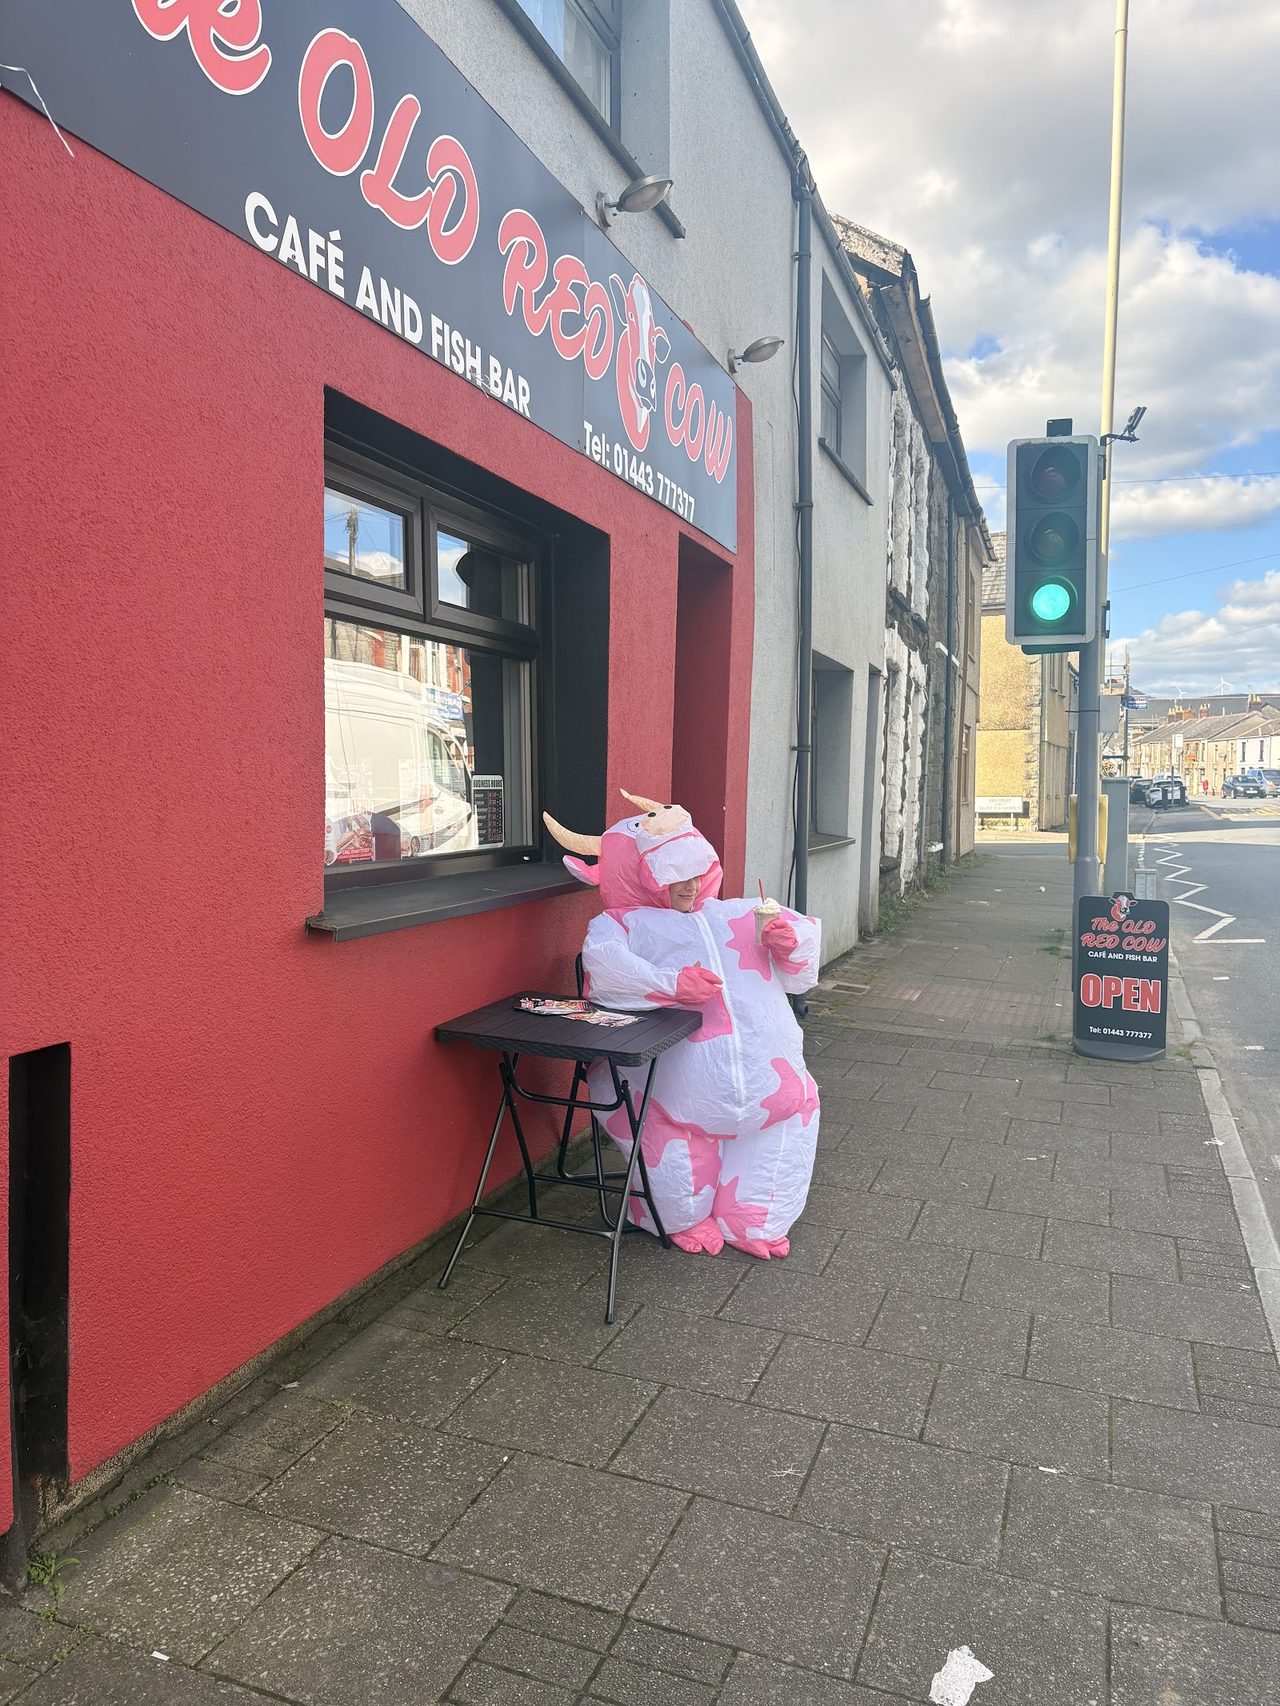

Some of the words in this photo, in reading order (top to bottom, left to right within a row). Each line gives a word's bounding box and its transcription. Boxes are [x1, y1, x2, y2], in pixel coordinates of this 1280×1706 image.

[298, 28, 479, 265] OLD
[498, 208, 614, 381] RED
[664, 362, 732, 484] COW
[244, 191, 345, 298] CAFÉ
[356, 266, 423, 345] AND
[430, 313, 481, 383] FISH
[488, 355, 531, 418] BAR
[583, 420, 611, 470] Tel:
[613, 443, 655, 496] 01443
[657, 471, 696, 523] 777377
[1091, 917, 1118, 931] The
[1122, 920, 1156, 934] OLD
[1081, 933, 1120, 950] RED
[1122, 936, 1167, 953] COW
[1088, 950, 1106, 959] CAFÉ
[1107, 953, 1124, 961] AND
[1125, 954, 1141, 962] FISH
[1142, 955, 1158, 963] BAR
[1081, 973, 1161, 1013] OPEN
[1089, 1026, 1102, 1034] Tel:
[1103, 1027, 1124, 1037] 01443
[1125, 1030, 1152, 1039] 777377
